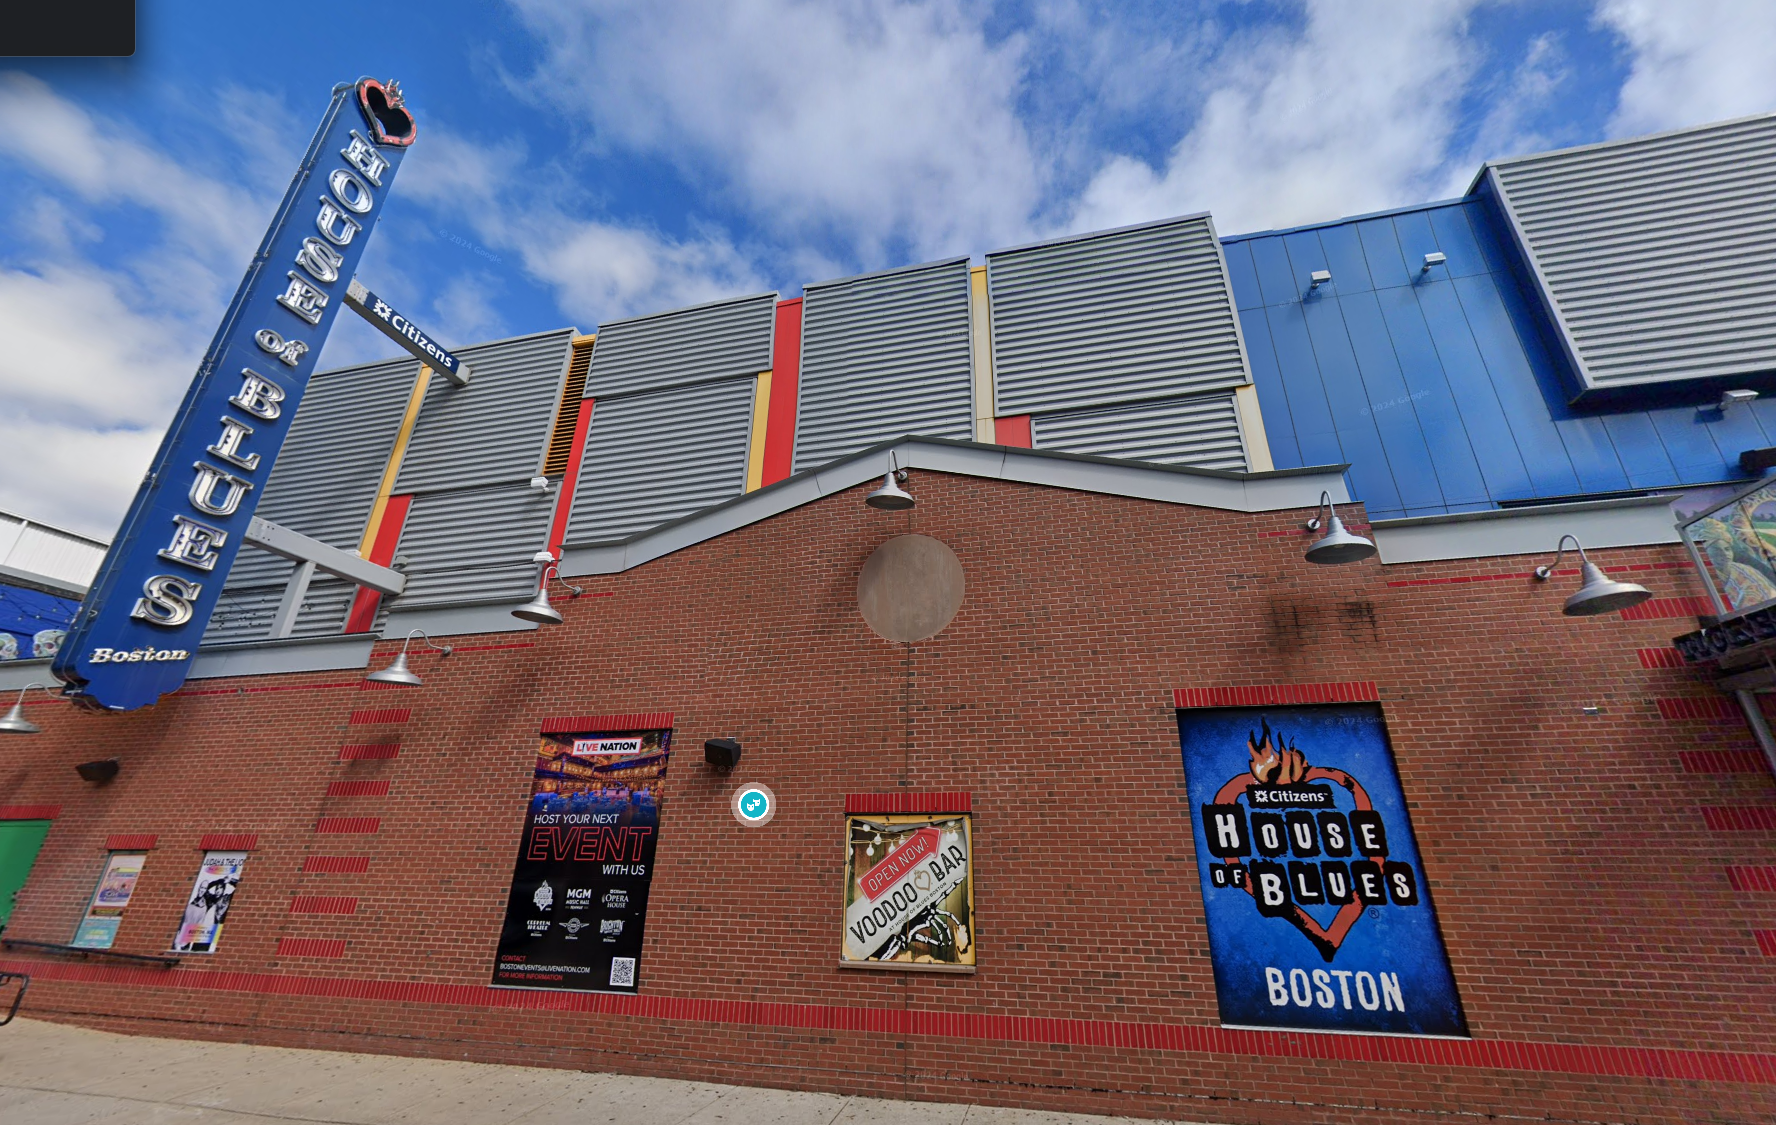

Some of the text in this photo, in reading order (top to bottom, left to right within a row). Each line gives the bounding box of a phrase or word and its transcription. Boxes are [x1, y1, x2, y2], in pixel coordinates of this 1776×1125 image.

[276, 129, 390, 325] HOUSE
[391, 315, 454, 368] Citizens
[130, 367, 286, 627] BLUES
[88, 646, 191, 664] Boston
[576, 740, 638, 753] LIVE NATION
[534, 814, 620, 825] HOST YOUR NEXT
[1215, 813, 1380, 850] HOUSE
[527, 826, 652, 862] EVENT
[602, 864, 646, 876] WITH US
[868, 836, 930, 892] OPEN NOW!
[566, 888, 592, 899] MGM
[605, 894, 629, 903] OPERA
[850, 844, 967, 944] VOODOO BAR
[895, 913, 910, 926] HOUSE
[916, 896, 930, 909] BLUES
[930, 882, 947, 897] BOSTON
[1215, 868, 1410, 906] OF BLUES
[500, 963, 591, 974] BOSTONEVENTS@LIVENATION.COM
[1264, 966, 1406, 1013] BOSTON
